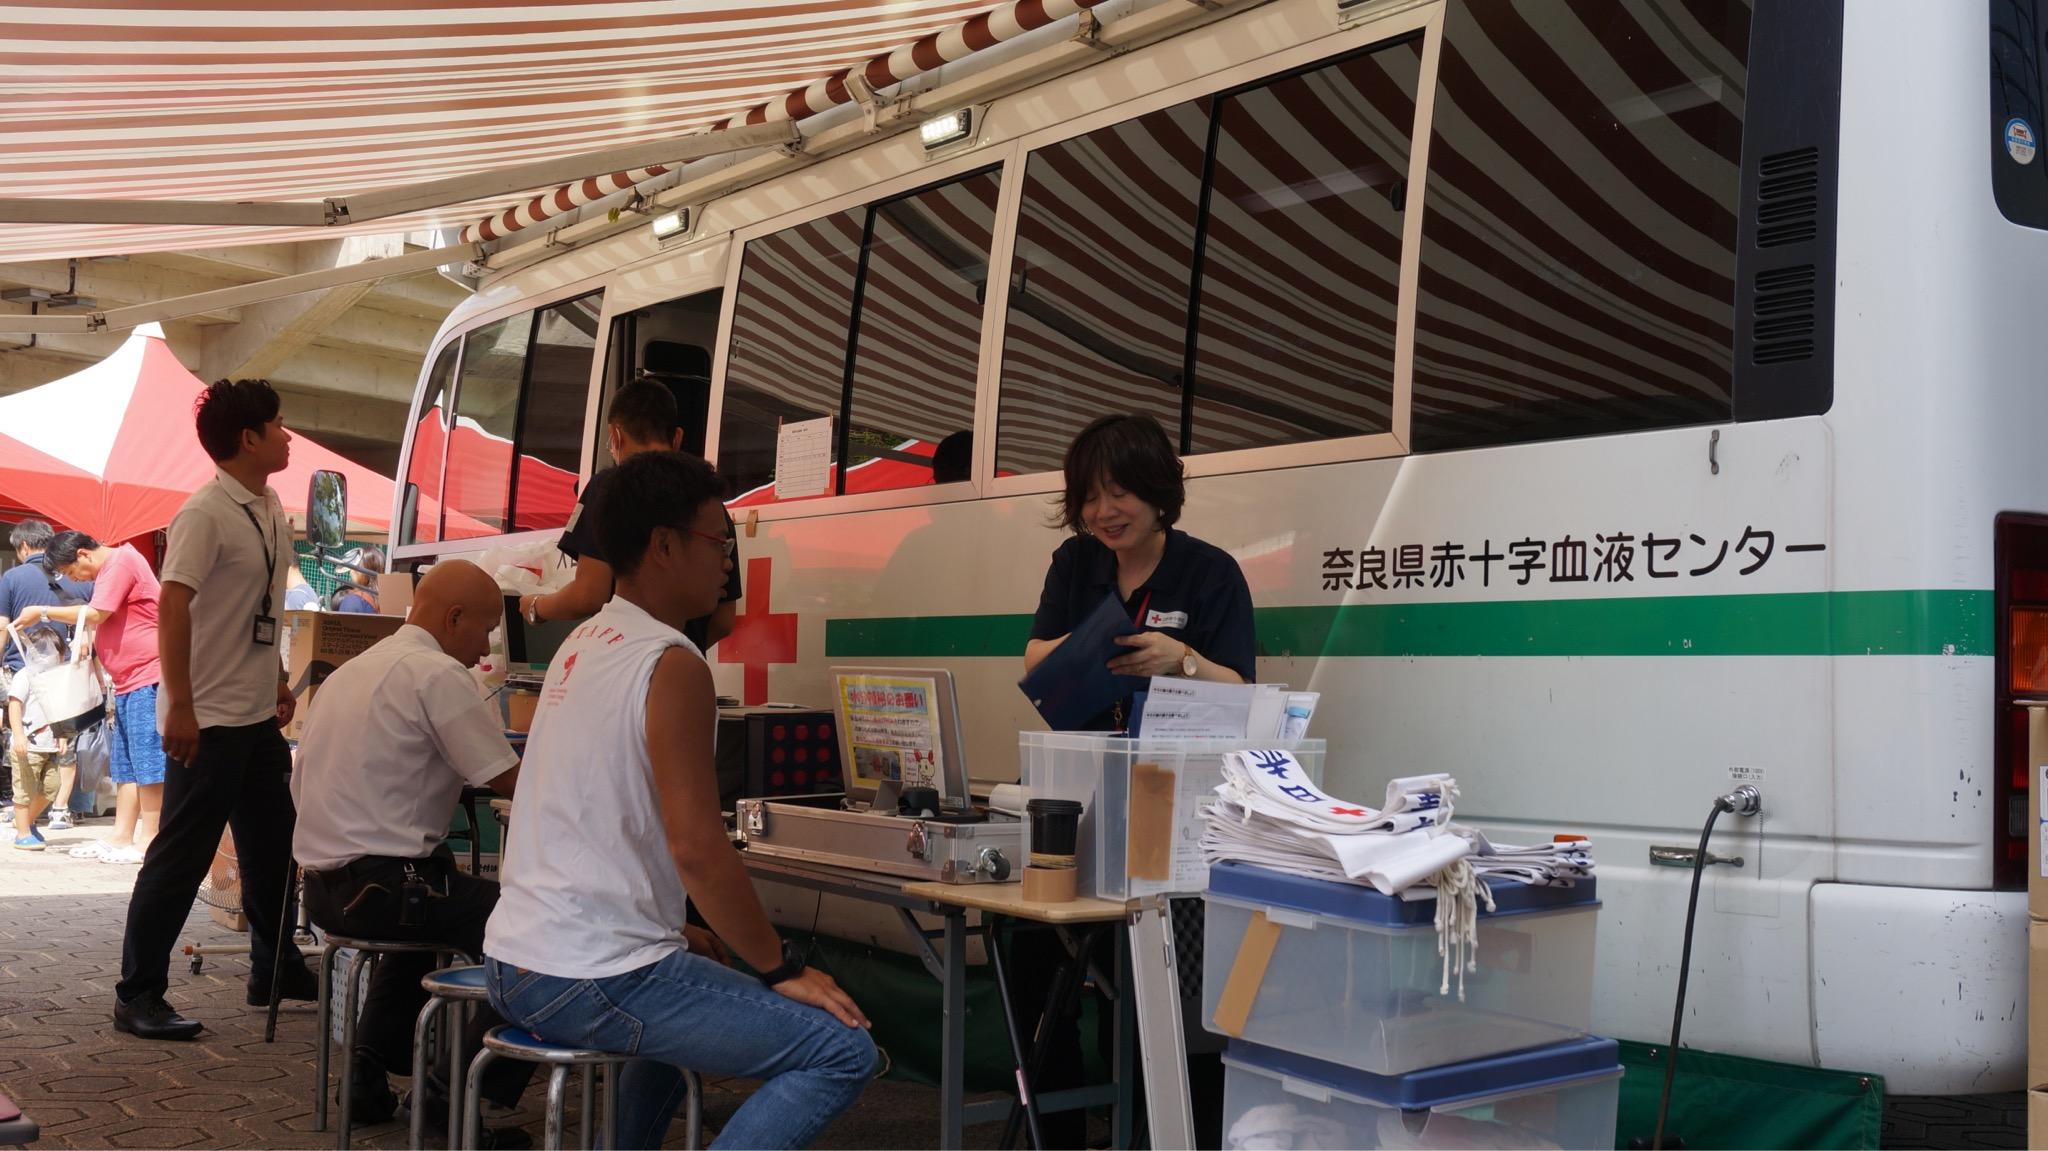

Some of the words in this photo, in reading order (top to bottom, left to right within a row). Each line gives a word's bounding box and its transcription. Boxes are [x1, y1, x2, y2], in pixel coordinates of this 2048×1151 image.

[1322, 525, 1827, 590] 奈良県赤十字血液センター
